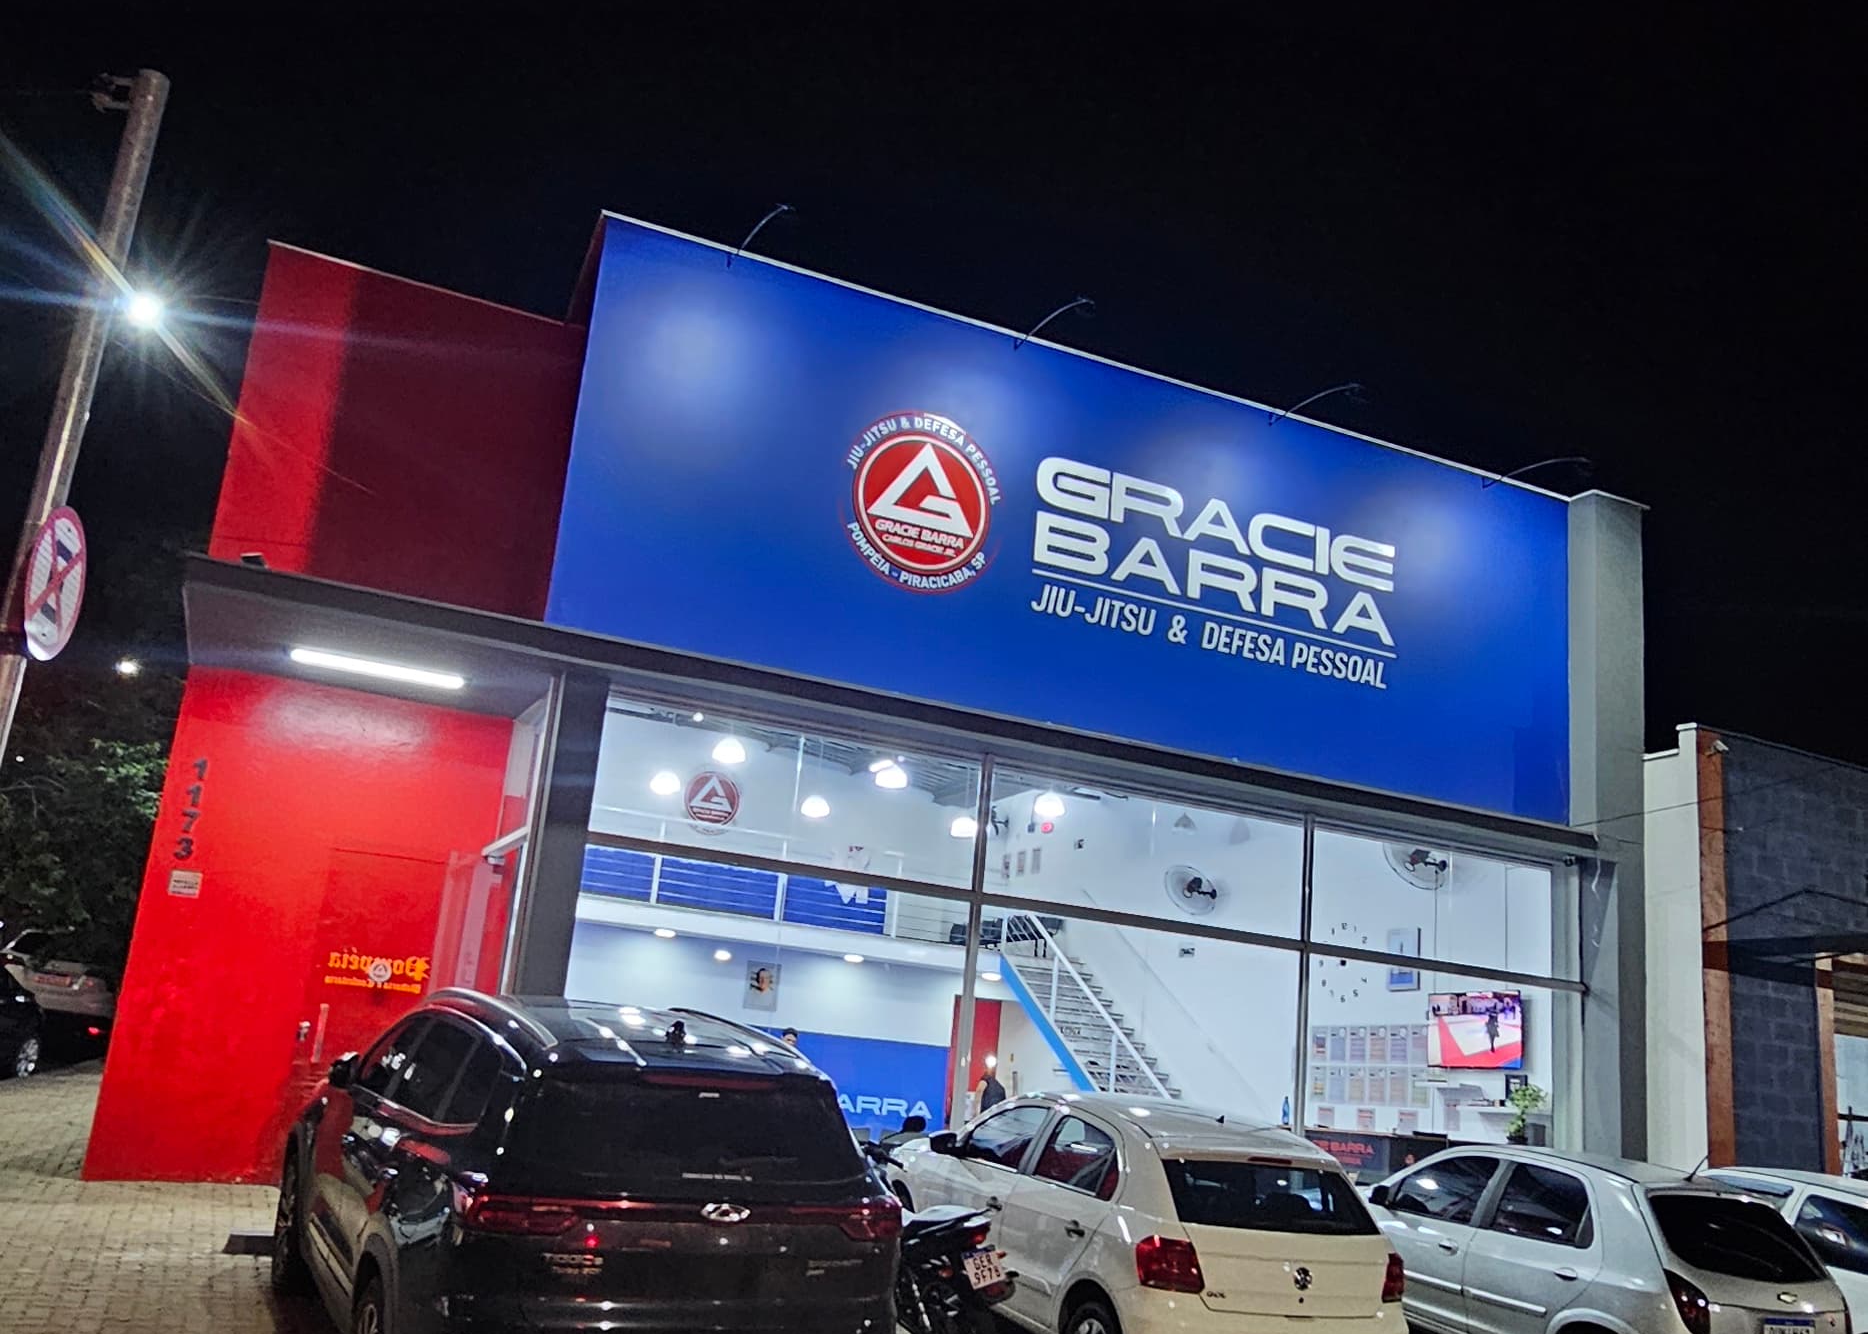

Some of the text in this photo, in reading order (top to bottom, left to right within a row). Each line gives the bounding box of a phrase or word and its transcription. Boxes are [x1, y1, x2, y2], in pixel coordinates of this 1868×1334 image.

[847, 416, 1001, 506] JIU-JITSU & DEFESA PESSOAL
[875, 519, 965, 550] GRACIE BARRA
[898, 563, 977, 590] PIRACICABA,
[970, 551, 987, 571] SP
[1036, 456, 1396, 593] GRACIE
[1033, 510, 1396, 647] BARRA
[1031, 583, 1388, 690] JIU-JITSU & DEFESA PESSOAL
[174, 757, 208, 860] 1173
[837, 1093, 933, 1120] ARRA
